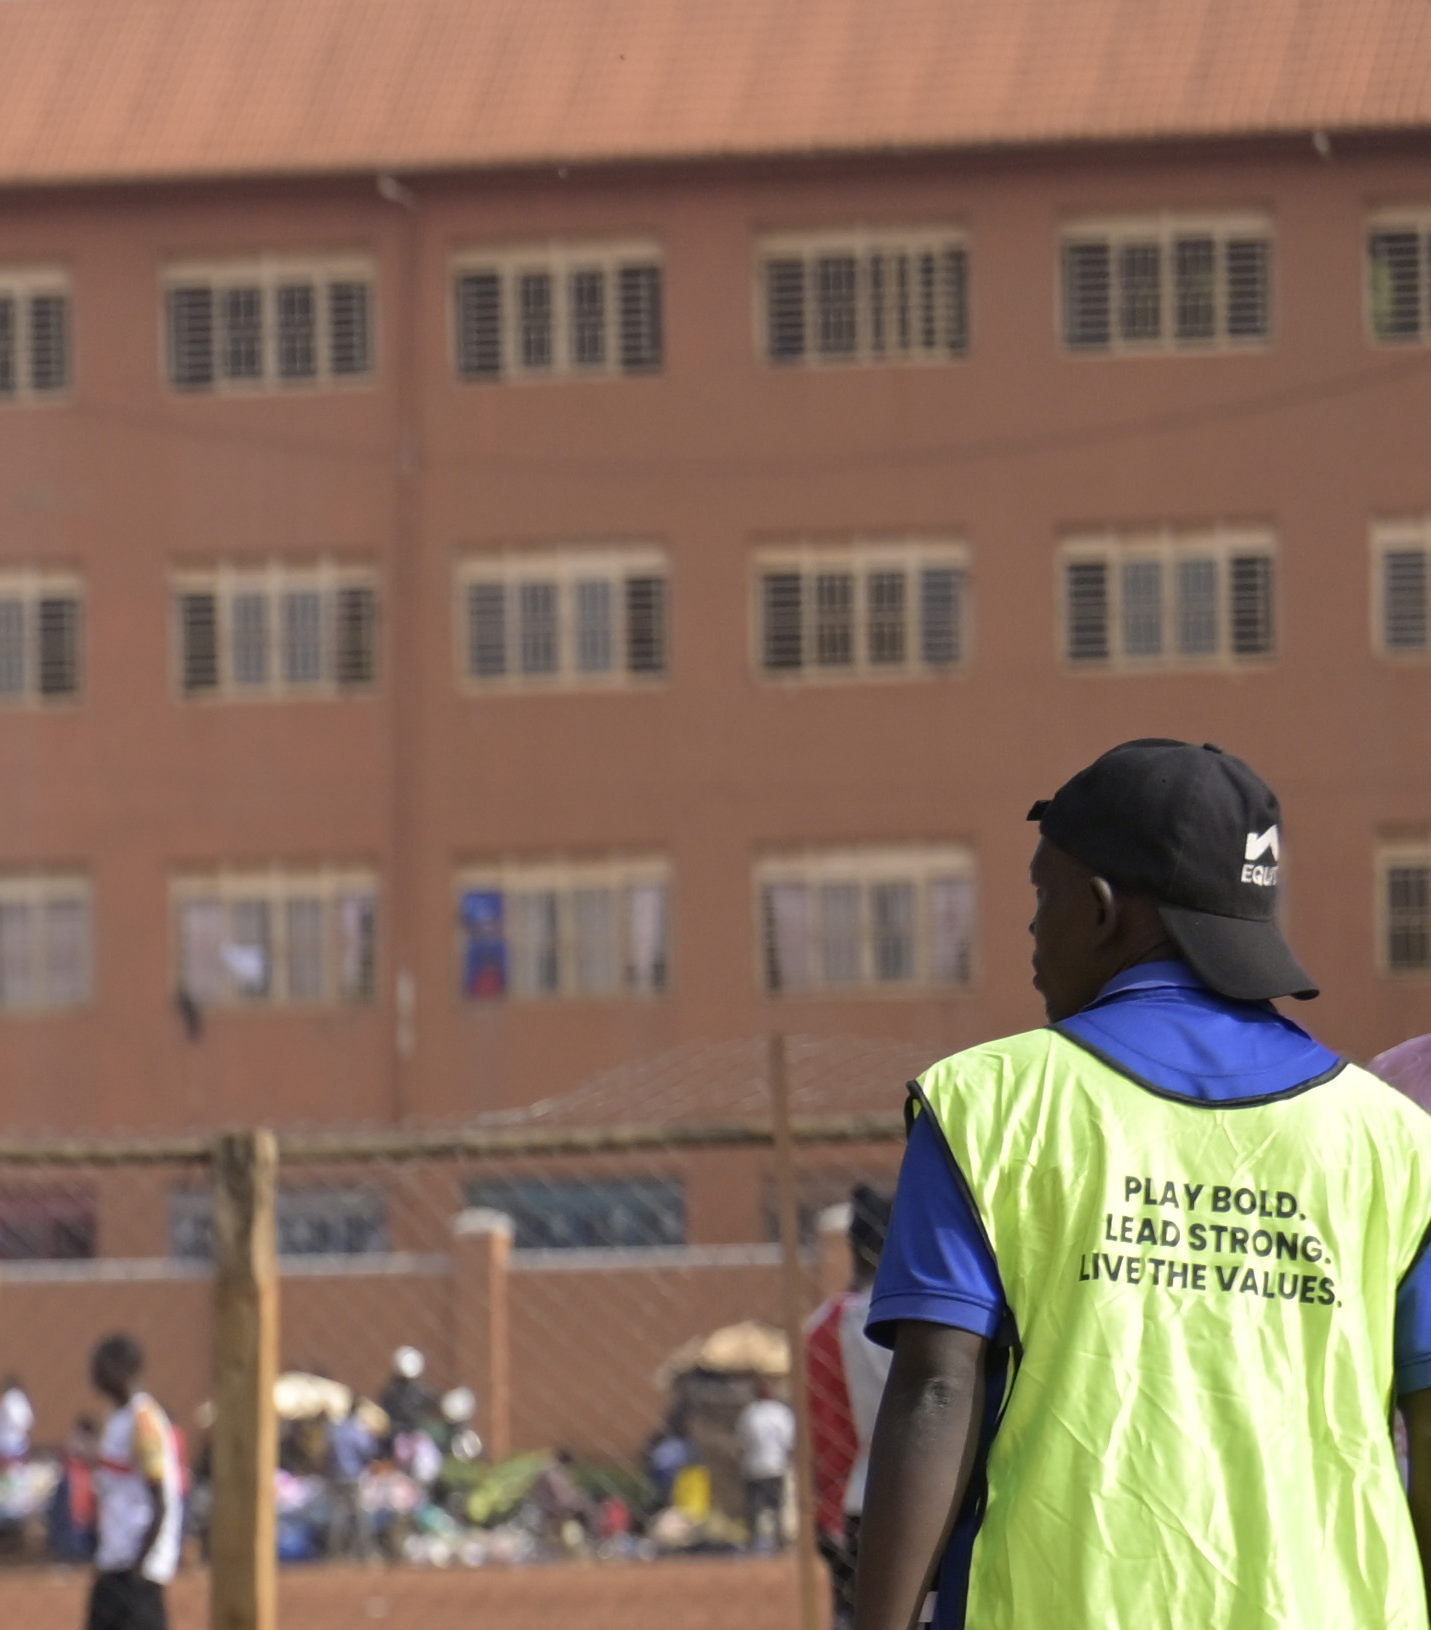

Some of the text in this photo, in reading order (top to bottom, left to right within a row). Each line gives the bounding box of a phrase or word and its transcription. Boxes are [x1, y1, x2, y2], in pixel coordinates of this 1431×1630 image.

[1124, 1175, 1307, 1221] PLAY BOLD.
[1105, 1213, 1332, 1265] LEAD STRONG.
[1078, 1252, 1343, 1308] LIVE THE VALUES.
